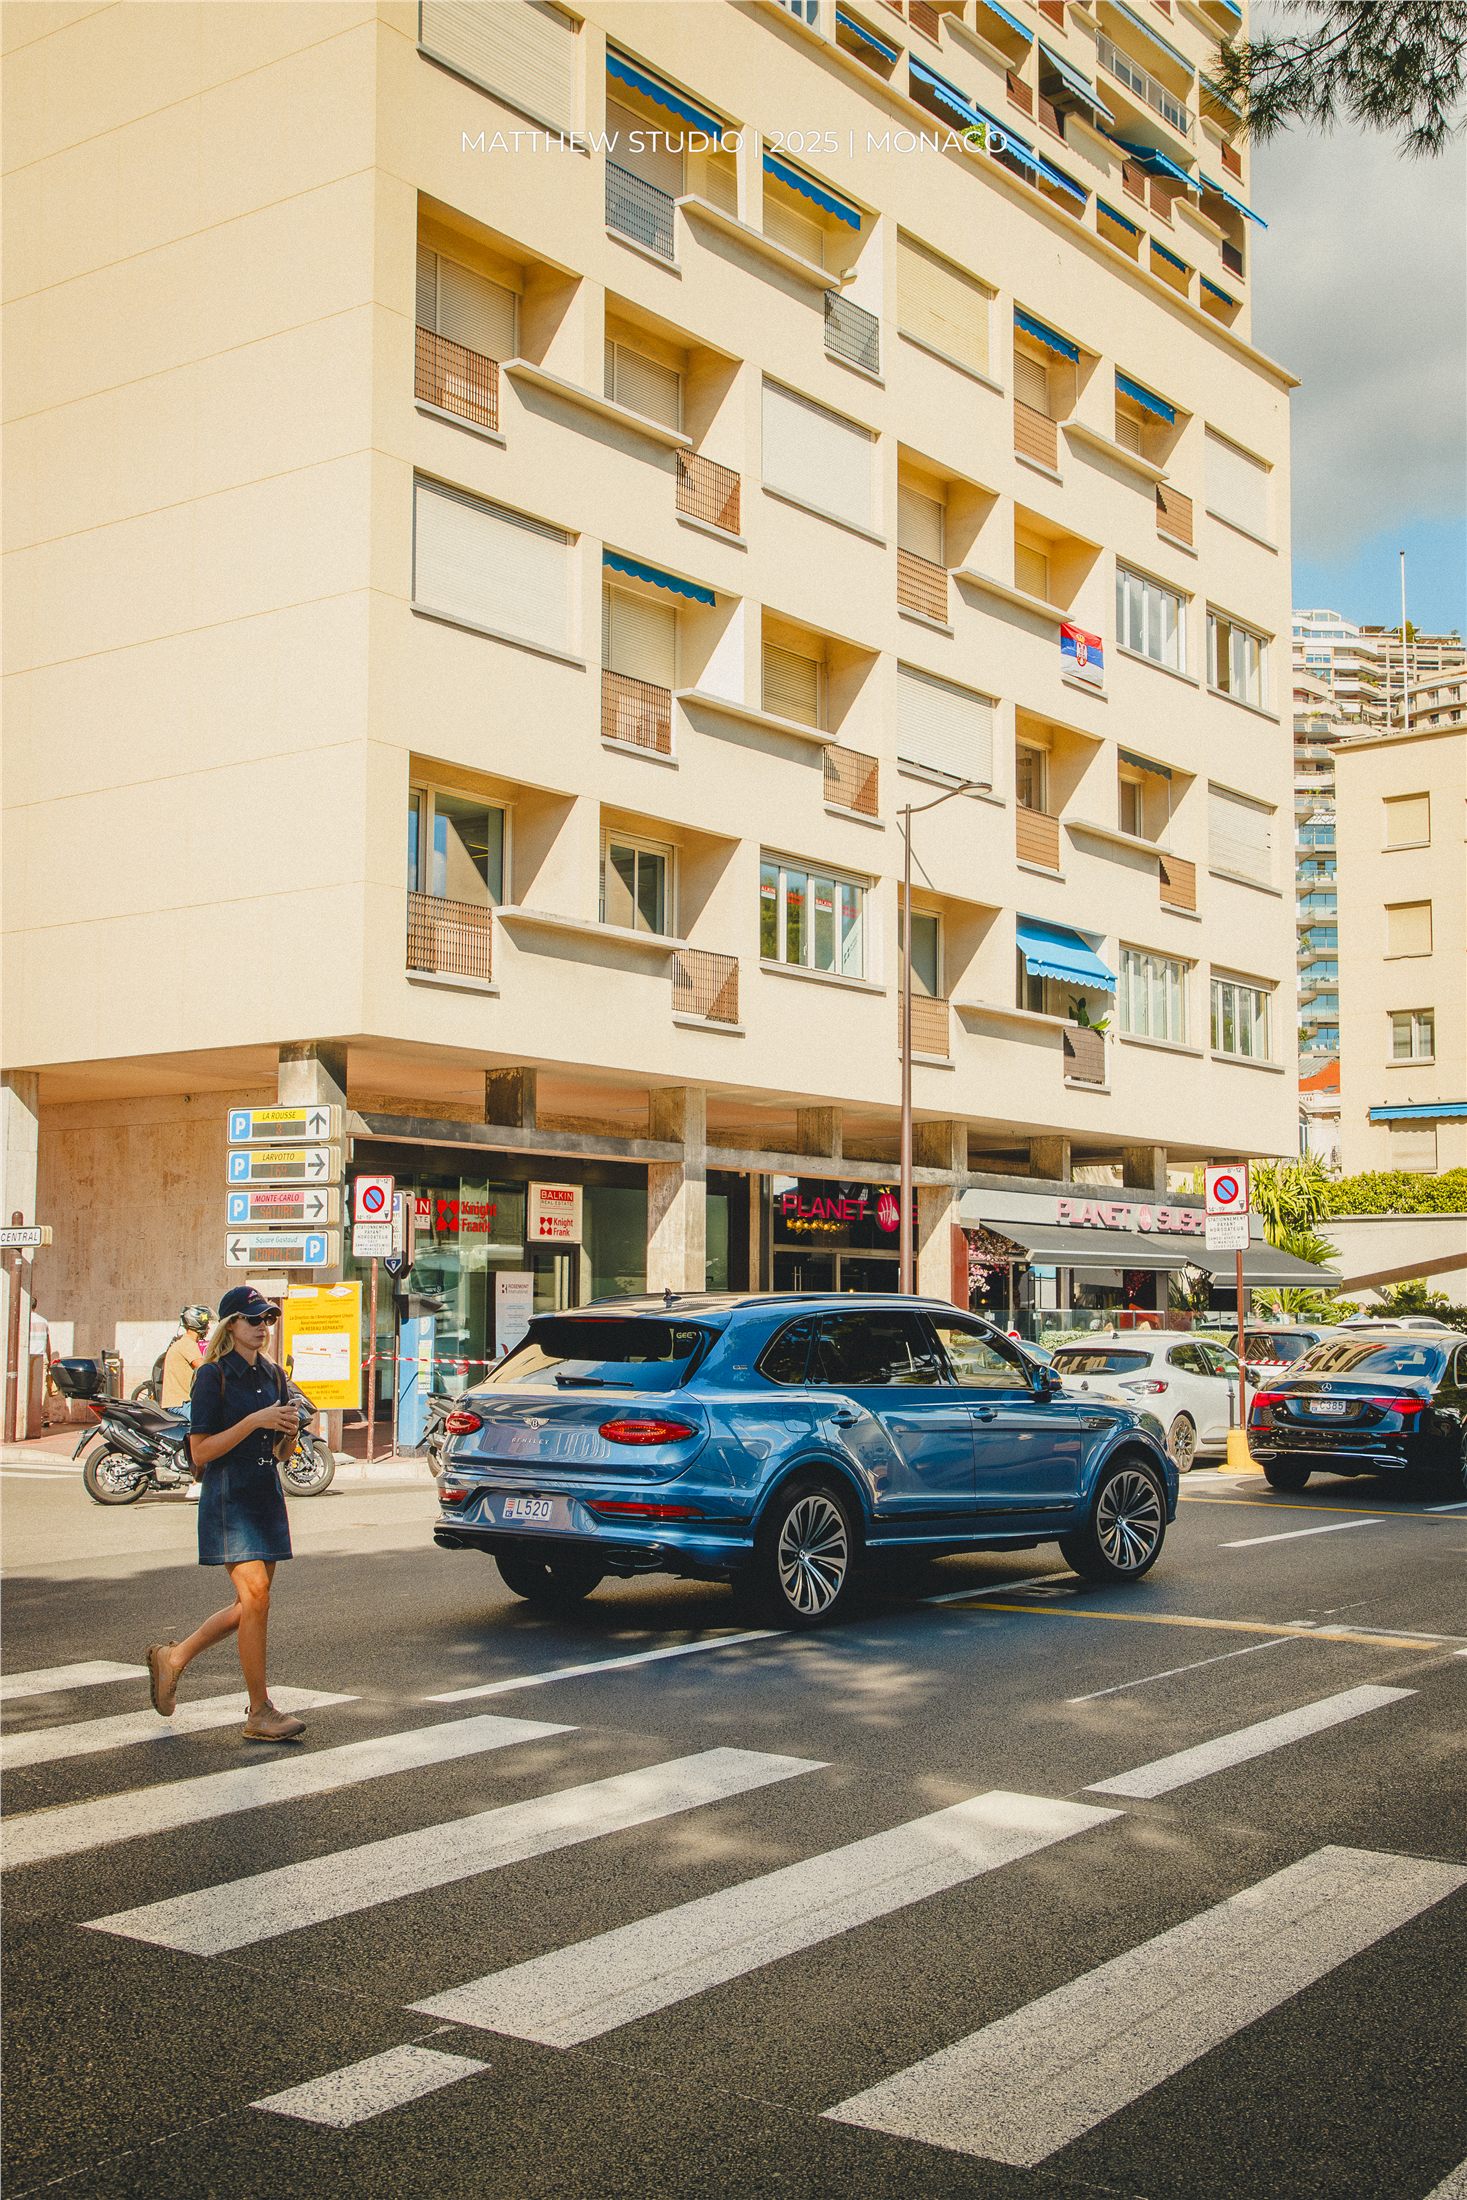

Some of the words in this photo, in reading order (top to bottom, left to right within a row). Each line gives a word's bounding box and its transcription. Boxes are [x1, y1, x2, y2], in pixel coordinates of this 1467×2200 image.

[271, 1111, 297, 1120] ROUSSE
[262, 1152, 295, 1161] LARVOTTO
[255, 1193, 300, 1203] MONTE-CARLO
[541, 1190, 573, 1201] BALKIN
[461, 1201, 497, 1219] Knight
[782, 1193, 869, 1221] PLANET
[1056, 1200, 1132, 1229] PLANET
[461, 1217, 491, 1233] Frank
[553, 1217, 574, 1229] Knight
[1157, 1208, 1206, 1234] SUSH
[1, 1232, 38, 1242] CENTRAL
[553, 1228, 571, 1237] Frank
[1320, 1401, 1344, 1410] C385
[516, 1499, 550, 1517] L520
